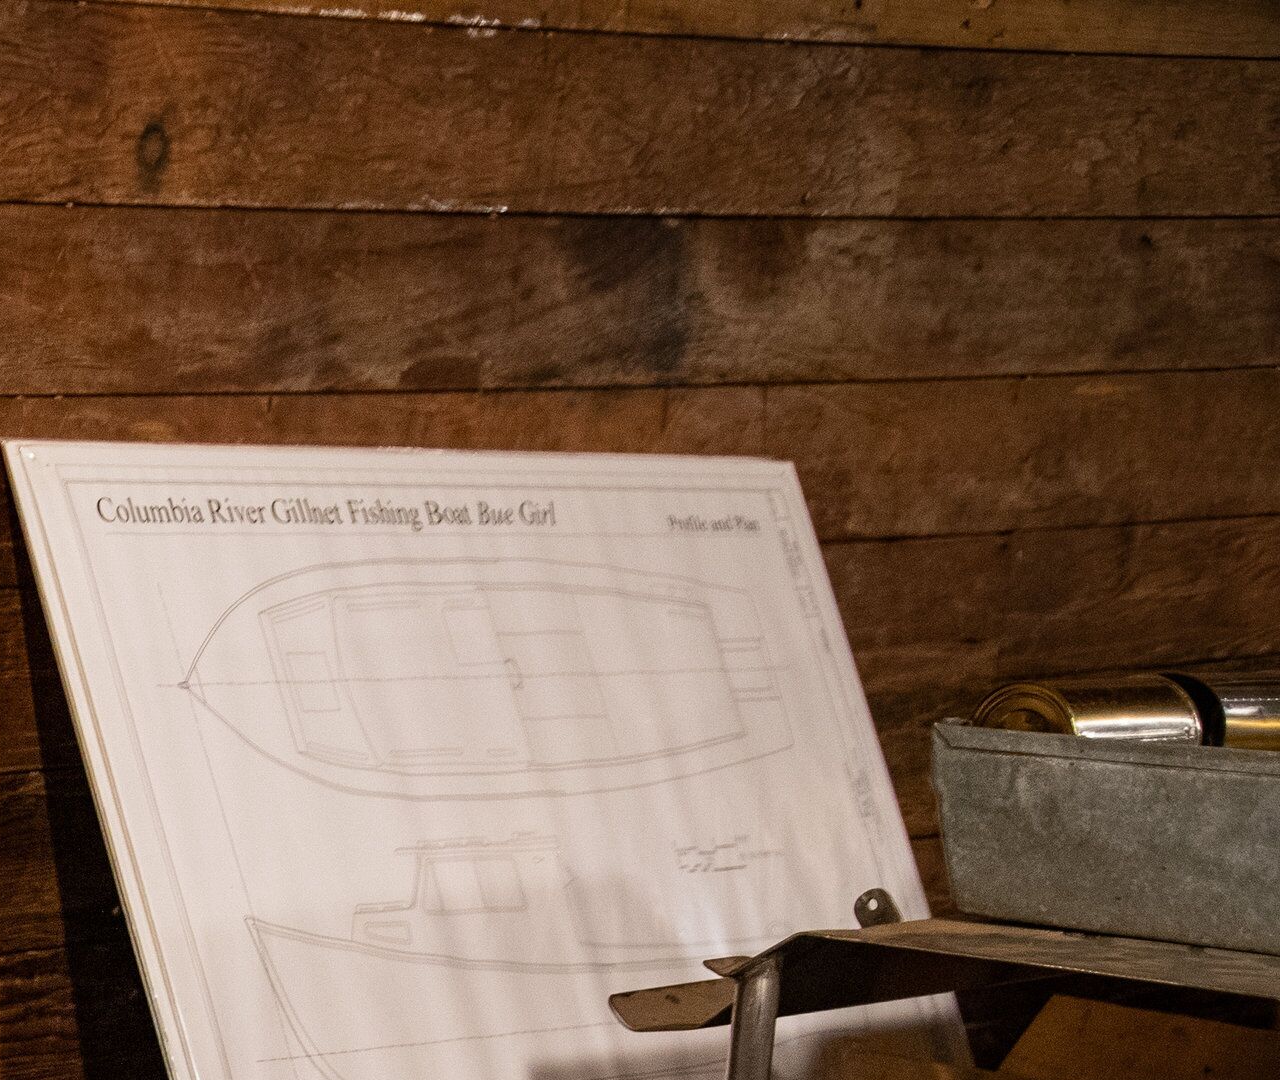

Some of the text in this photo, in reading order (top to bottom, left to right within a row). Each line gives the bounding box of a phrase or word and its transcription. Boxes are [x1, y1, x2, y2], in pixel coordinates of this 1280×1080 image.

[96, 496, 205, 525] Columbia
[208, 497, 266, 525] River
[270, 497, 343, 526] Gillnet
[346, 498, 423, 532] Fishing
[425, 500, 472, 526] Boat
[518, 499, 557, 526] Girl
